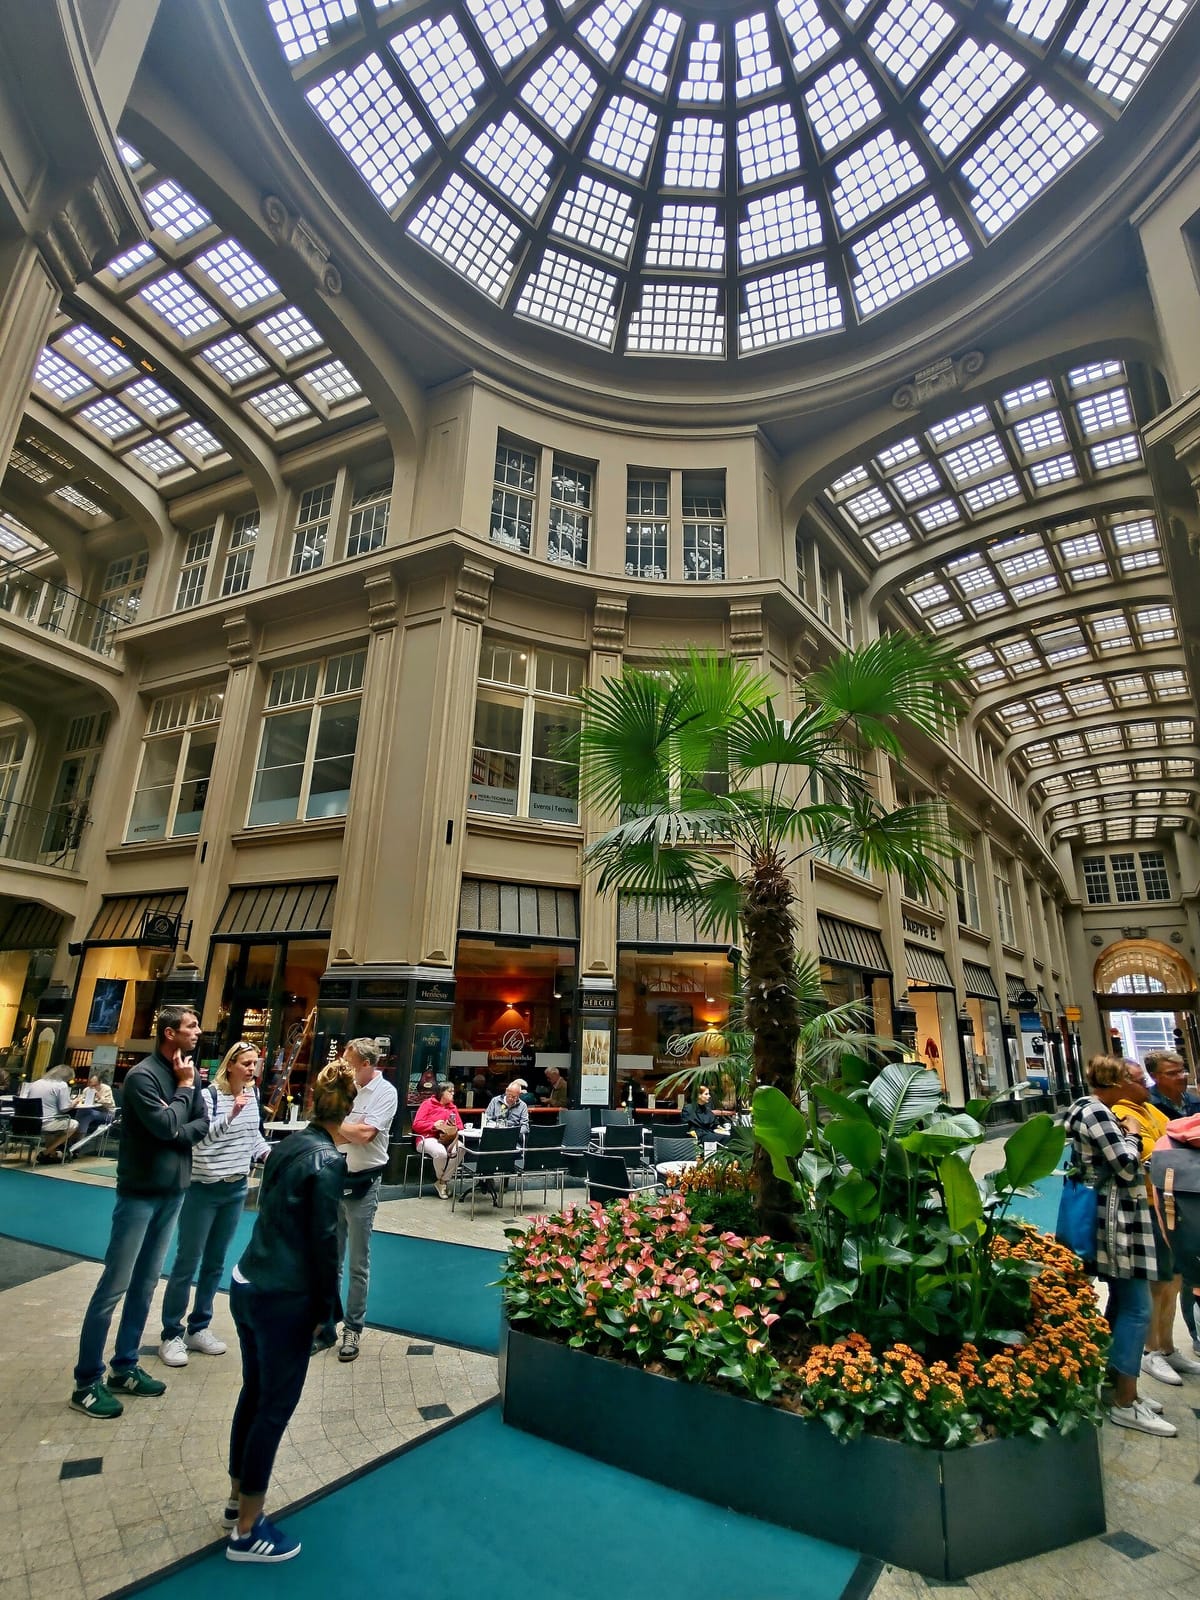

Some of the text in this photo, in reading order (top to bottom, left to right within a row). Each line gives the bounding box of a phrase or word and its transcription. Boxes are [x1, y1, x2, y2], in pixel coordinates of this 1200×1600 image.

[533, 802, 573, 813] Events Technik
[930, 925, 937, 941] E
